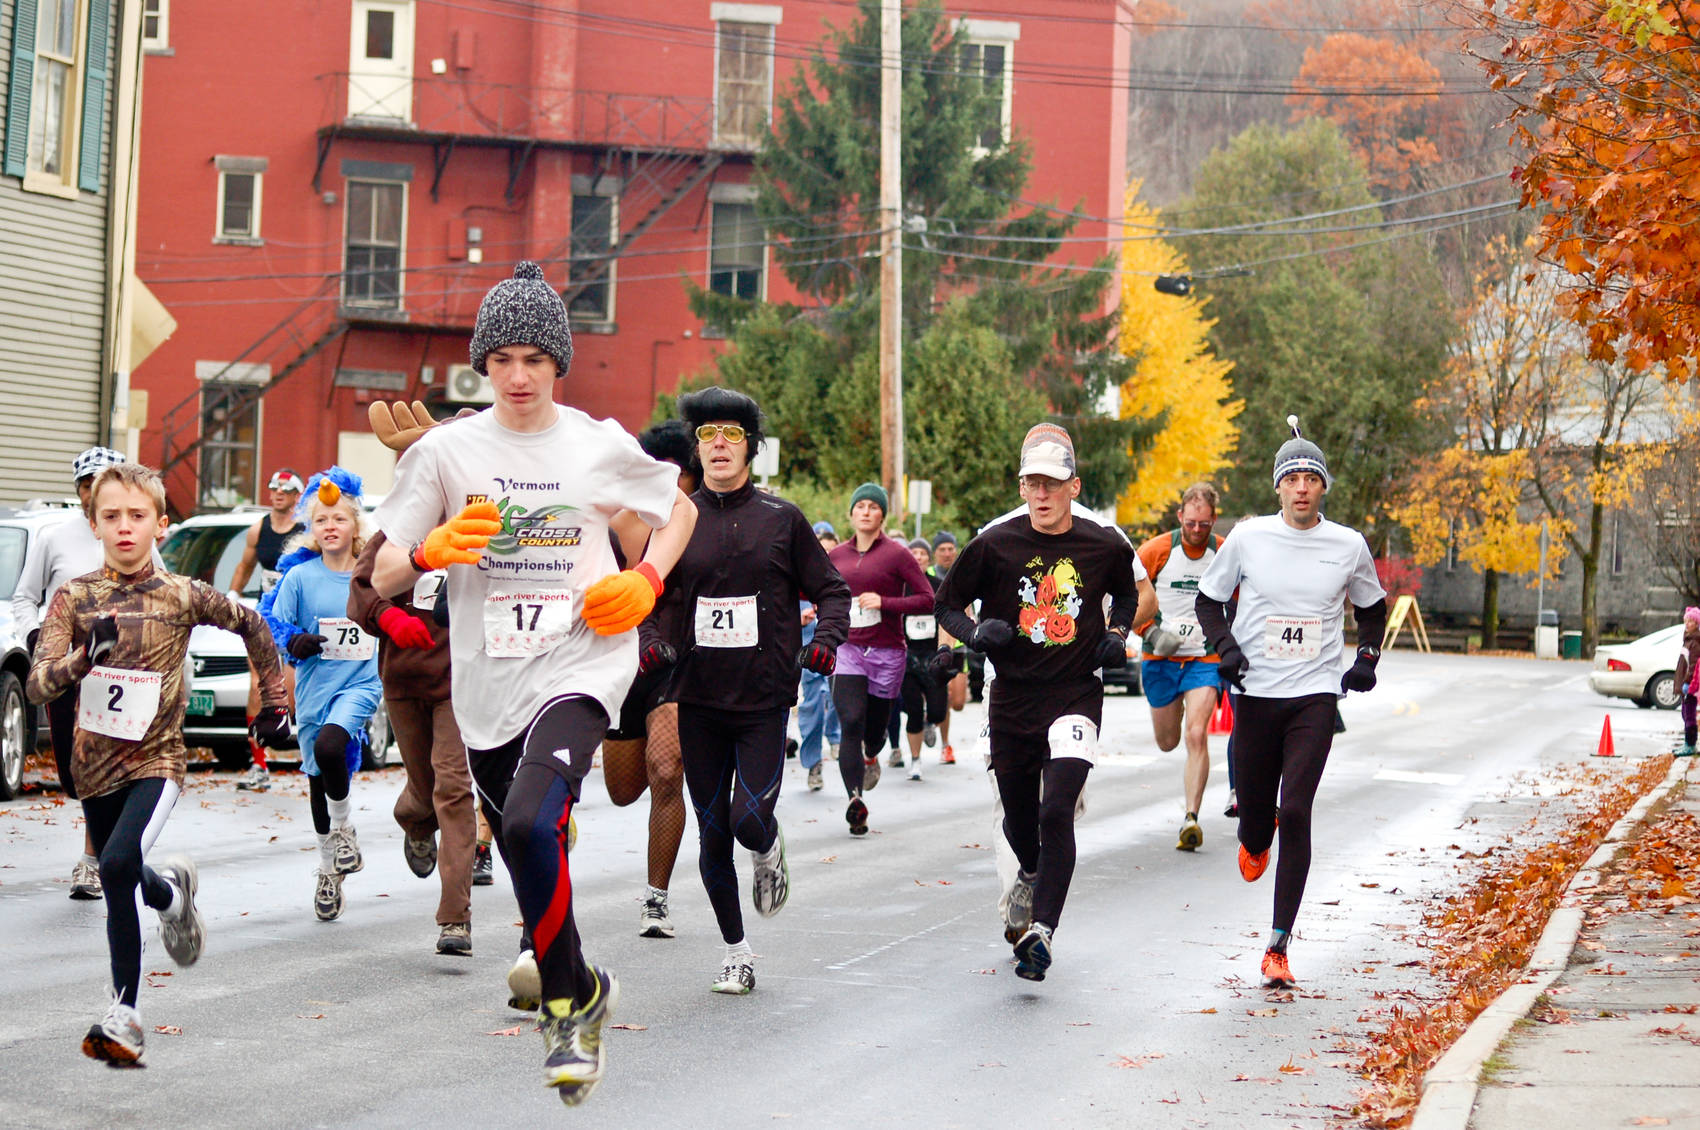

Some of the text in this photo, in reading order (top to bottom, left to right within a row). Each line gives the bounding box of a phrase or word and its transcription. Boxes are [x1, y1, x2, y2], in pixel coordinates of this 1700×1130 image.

[493, 477, 560, 492] Vermont
[516, 529, 578, 538] CROSS
[518, 538, 580, 547] COUNTRY
[477, 556, 574, 574] Championship
[513, 593, 536, 601] river
[539, 593, 570, 602] sports
[512, 603, 543, 631] 17
[711, 609, 734, 629] 21
[336, 627, 360, 646] 73
[1179, 624, 1194, 637] 37
[1281, 627, 1304, 644] 44
[104, 672, 126, 681] river
[128, 675, 160, 684] sports
[107, 684, 124, 713] 2
[1072, 725, 1083, 741] 5
